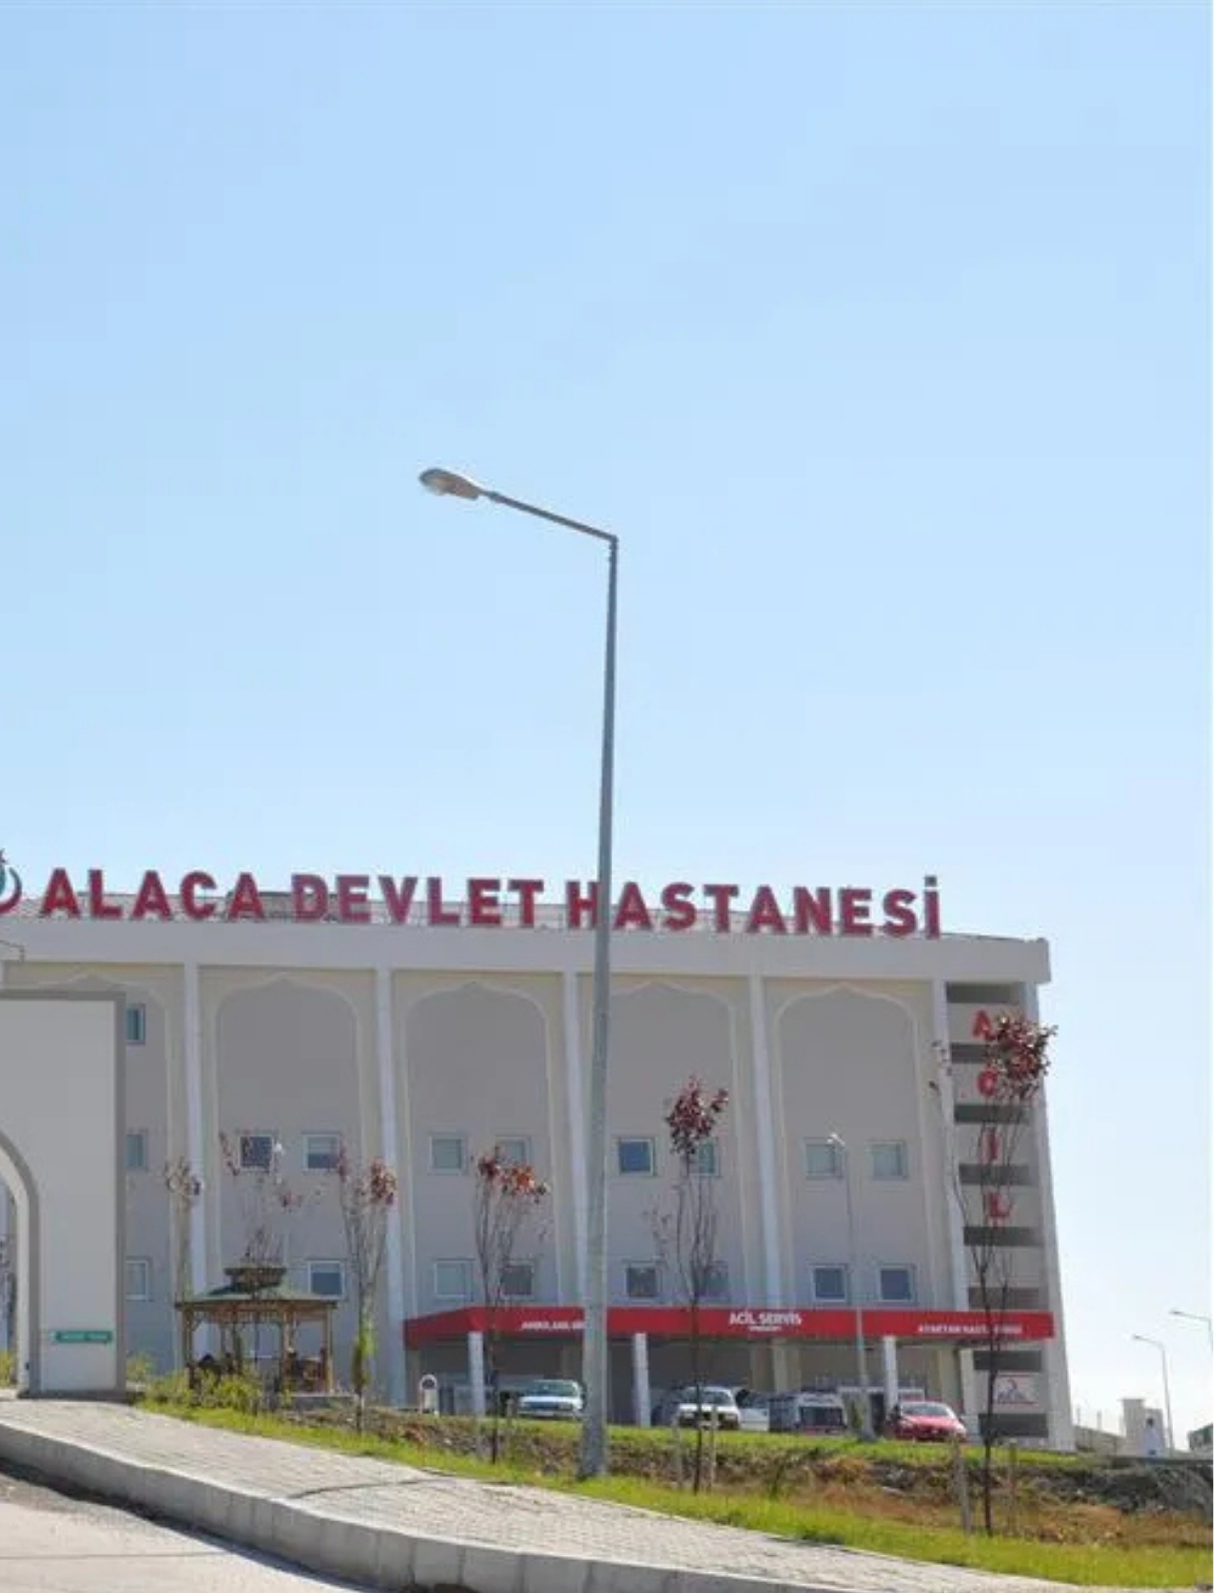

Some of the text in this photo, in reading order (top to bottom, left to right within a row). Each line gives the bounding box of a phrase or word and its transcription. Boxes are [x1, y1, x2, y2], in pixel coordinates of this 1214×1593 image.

[38, 867, 941, 940] ALACA DEVLET HASTANESİ
